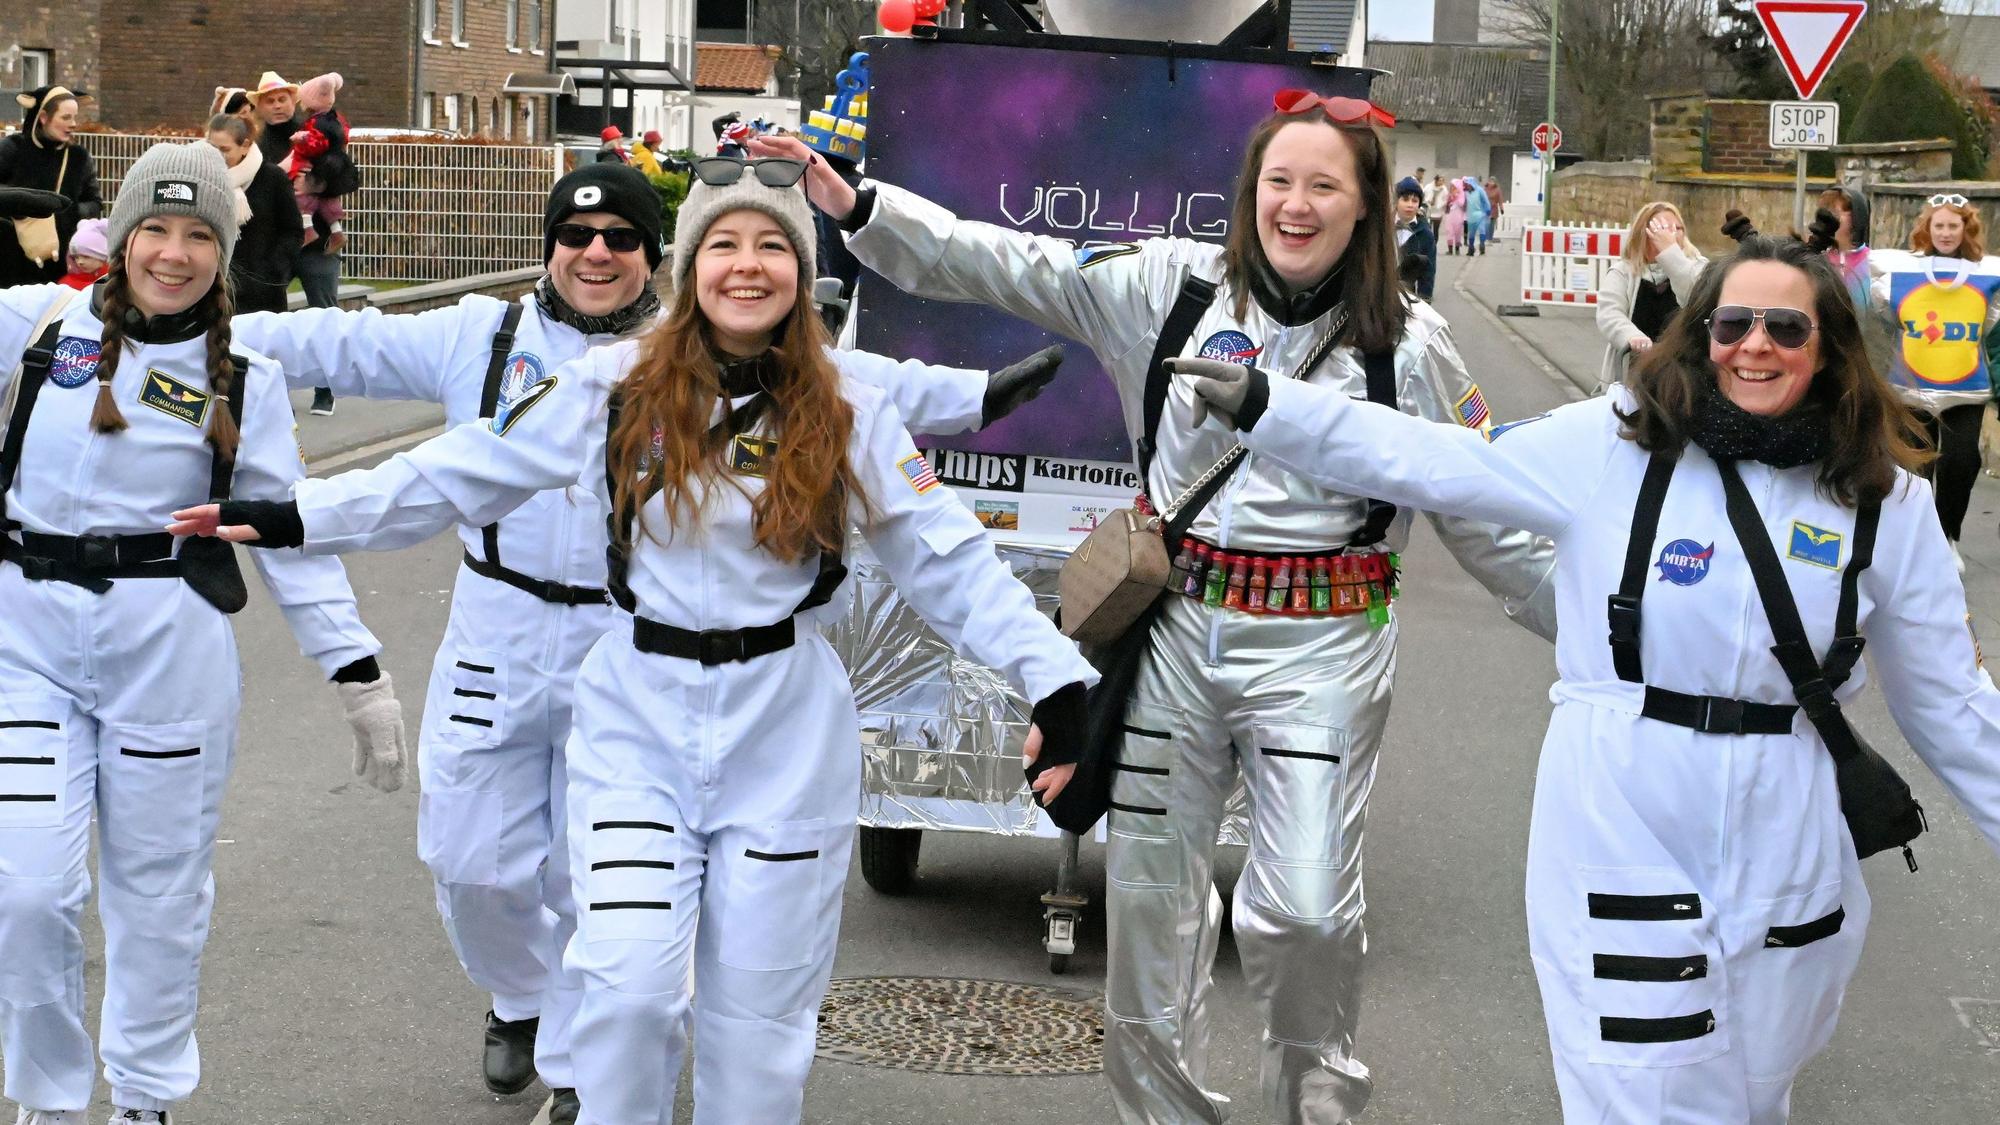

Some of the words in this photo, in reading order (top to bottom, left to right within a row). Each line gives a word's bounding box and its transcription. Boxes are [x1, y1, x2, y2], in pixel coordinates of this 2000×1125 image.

[1782, 109, 1826, 126] STOP
[1535, 132, 1559, 144] STP
[1000, 181, 1227, 236] VÖLLIG
[54, 348, 98, 373] SPACE
[1202, 346, 1253, 366] SPACE
[149, 394, 195, 419] COMMANDER
[1032, 458, 1141, 489] Kartoffe
